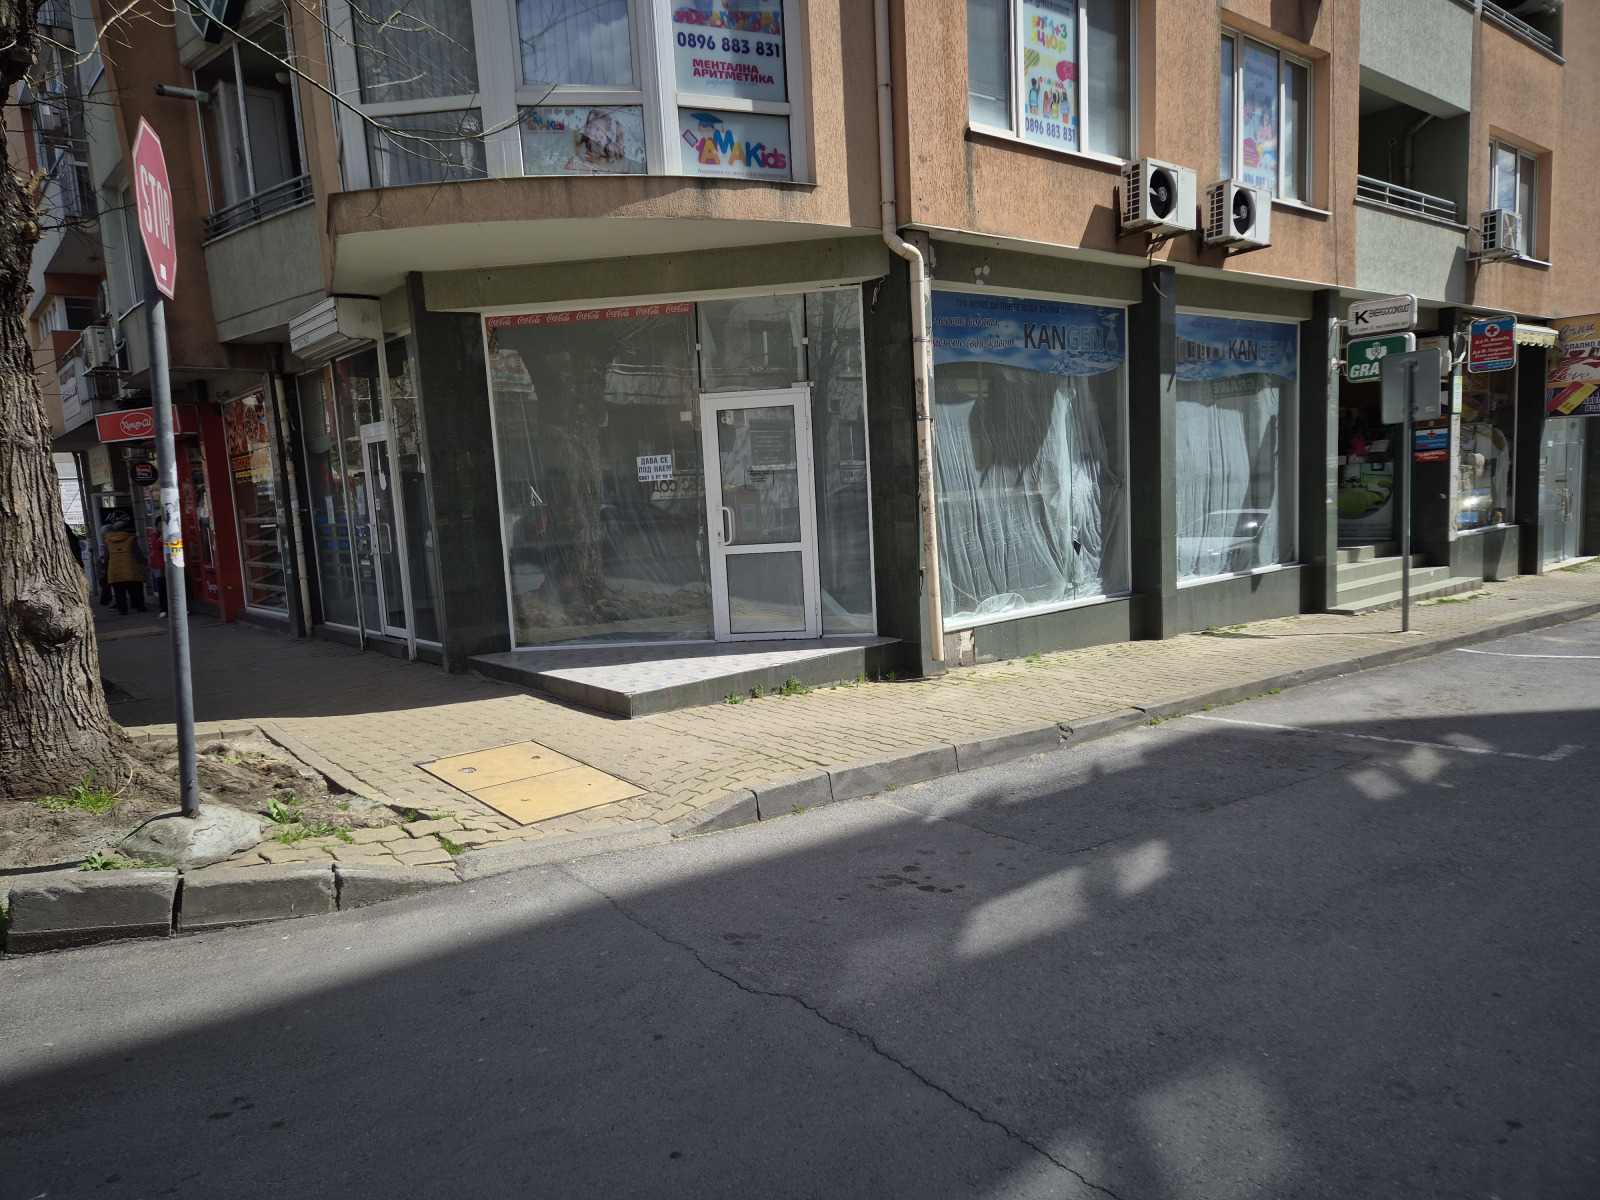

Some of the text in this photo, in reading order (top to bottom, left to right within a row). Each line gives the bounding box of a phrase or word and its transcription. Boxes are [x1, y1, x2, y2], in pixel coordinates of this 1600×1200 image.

[677, 32, 780, 58] 0896 883 831
[692, 59, 759, 74] МЕНТАЛНА
[693, 68, 775, 84] АРИТМЕТИКА
[1025, 116, 1076, 143] 0896 883 831
[700, 129, 787, 169] AMAKids
[140, 164, 170, 249] STOP
[956, 298, 968, 307] ТУК
[969, 299, 989, 309] МОЖЕ
[990, 301, 999, 310] ДА
[1000, 302, 1021, 312] ПИЕТЕ
[1021, 304, 1038, 313] ВОДА
[1369, 303, 1410, 318] ENERGOCONSULT
[1023, 322, 1104, 352] KANGEN
[1564, 341, 1595, 350] СПАЛНО
[640, 456, 668, 465] ДАВА СЕ
[638, 464, 672, 473] ПОД НАЕМ
